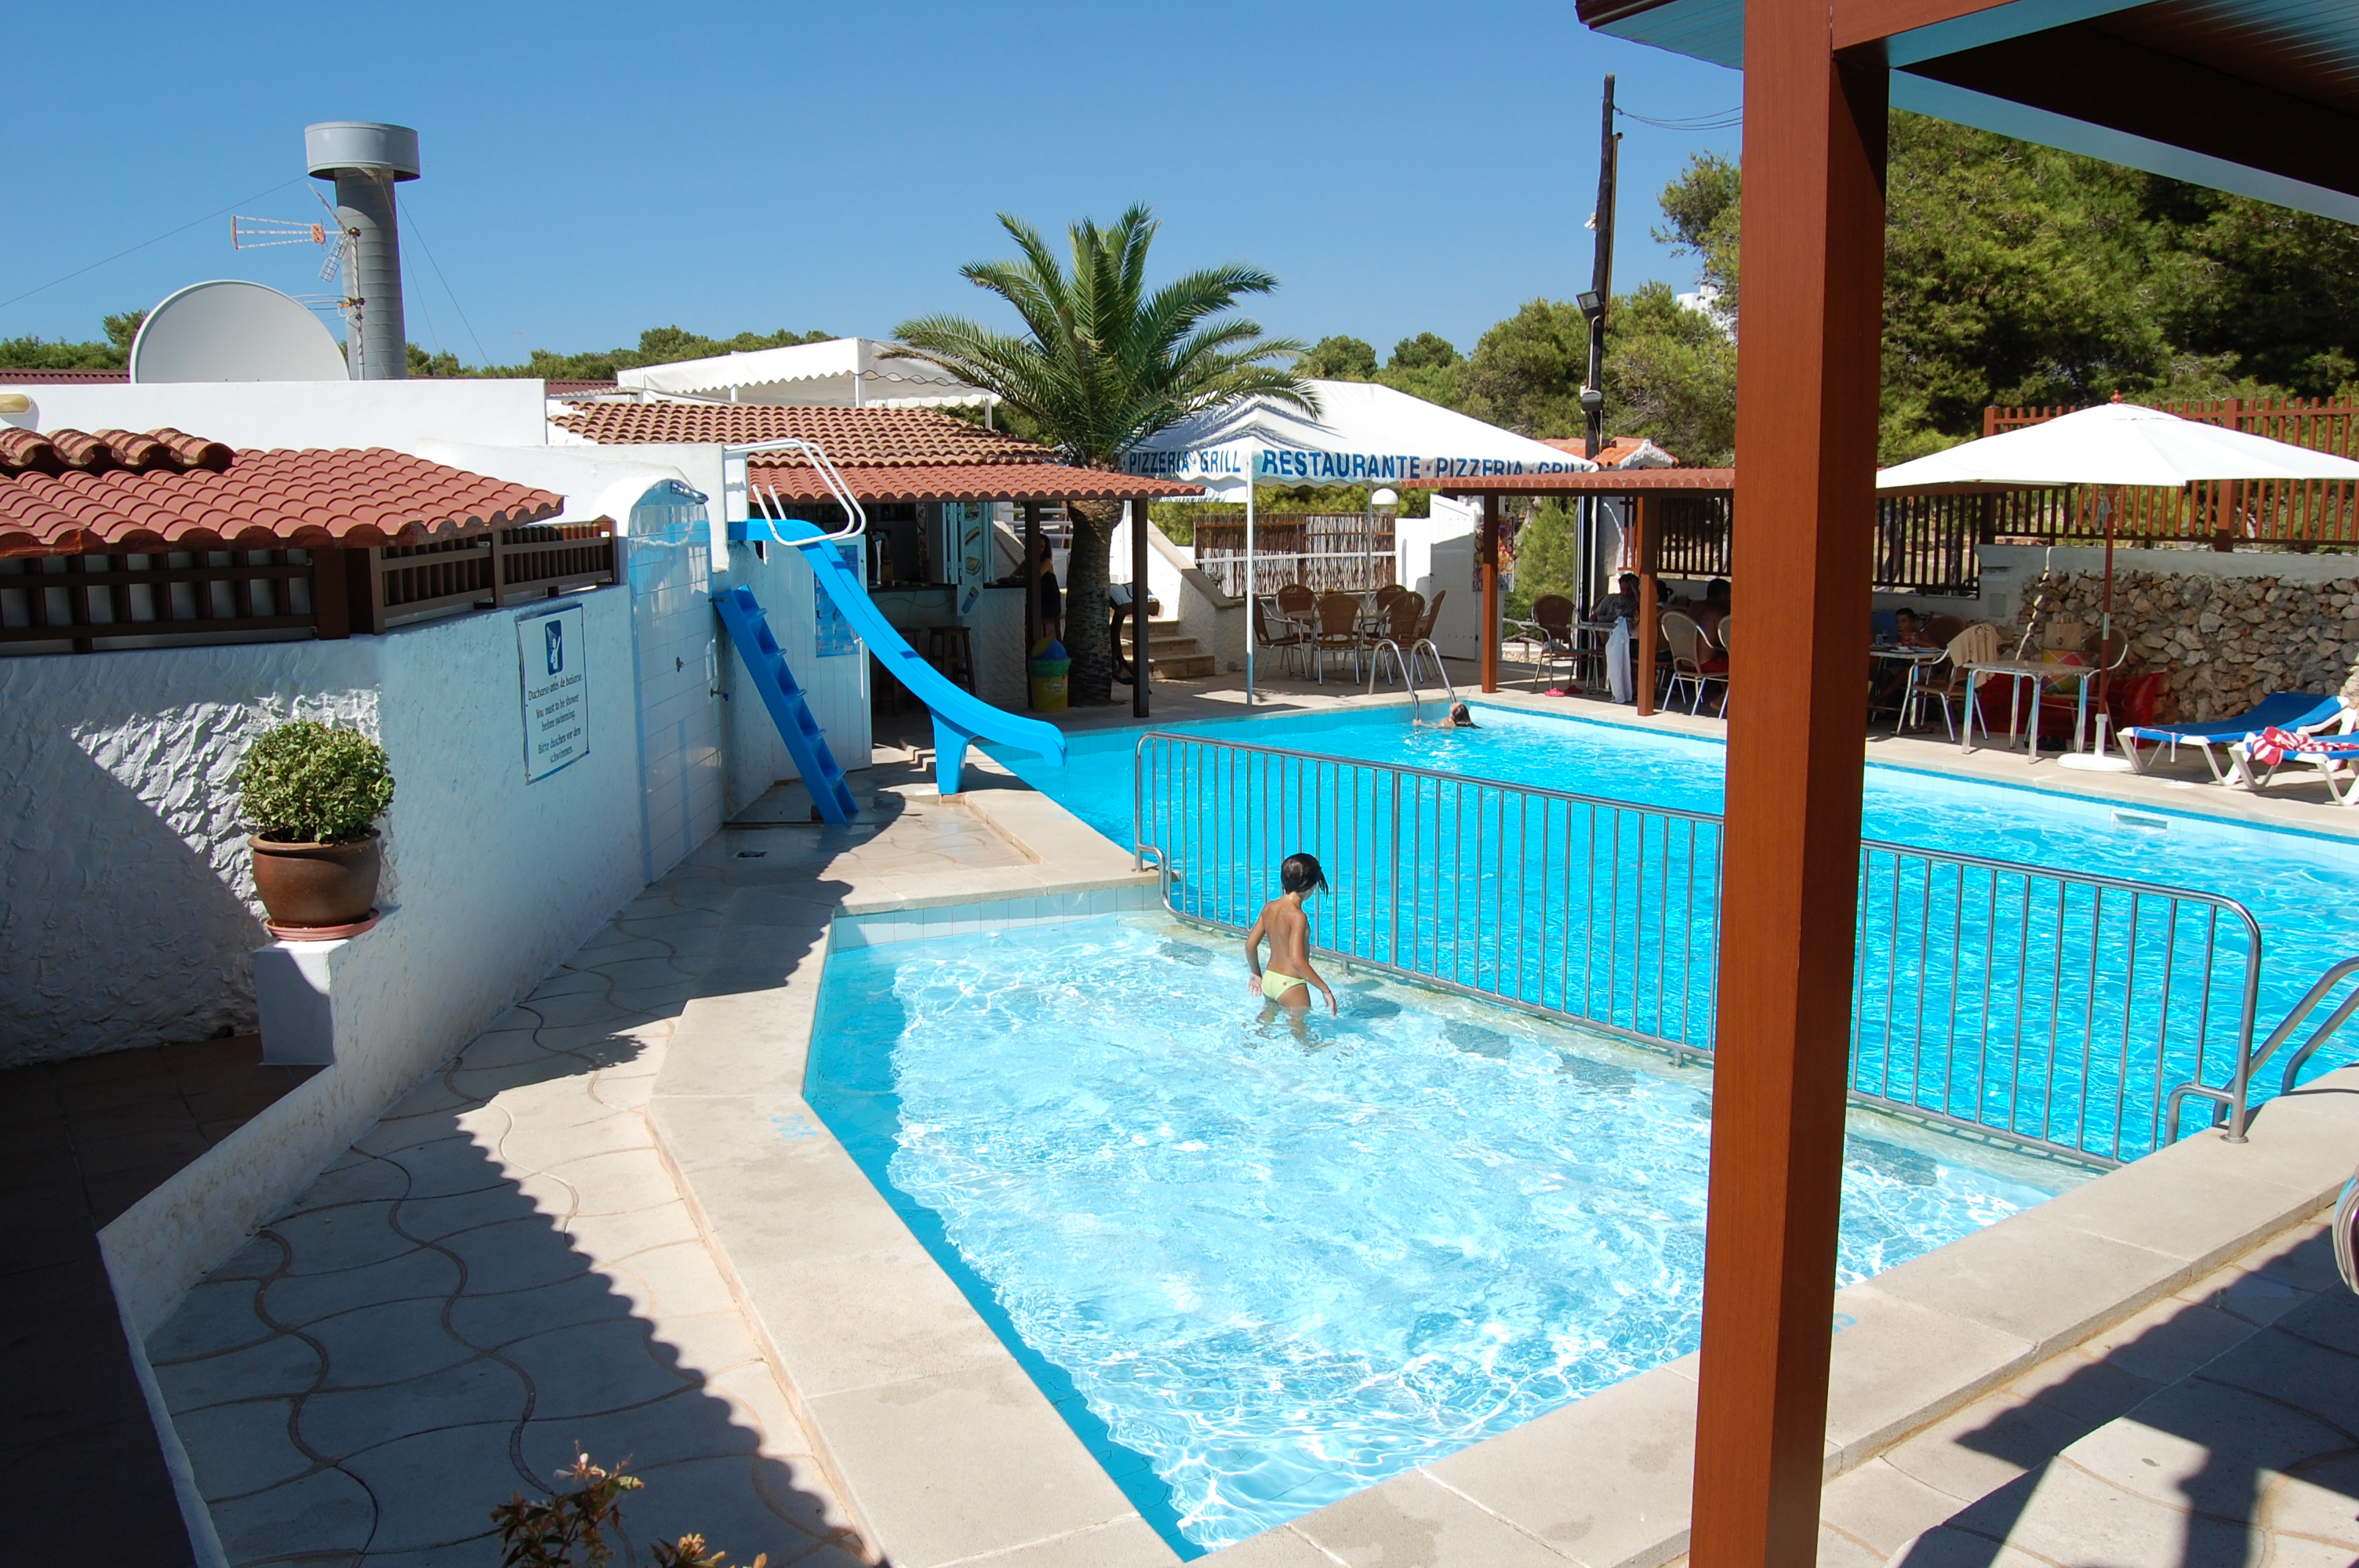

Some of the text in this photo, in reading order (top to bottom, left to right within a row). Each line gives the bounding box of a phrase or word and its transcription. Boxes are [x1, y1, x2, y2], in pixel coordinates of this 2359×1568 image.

[1129, 449, 1241, 474] PIZZERIA GRILL
[1261, 449, 1420, 479] RESTAURANTE
[1436, 457, 1523, 478] PIZZERIA
[528, 687, 550, 701] Ducharse
[560, 677, 565, 688] de
[536, 694, 580, 719] You must to be shower
[541, 719, 555, 732] before
[538, 742, 550, 754] Bitte
[550, 734, 566, 749] duschen
